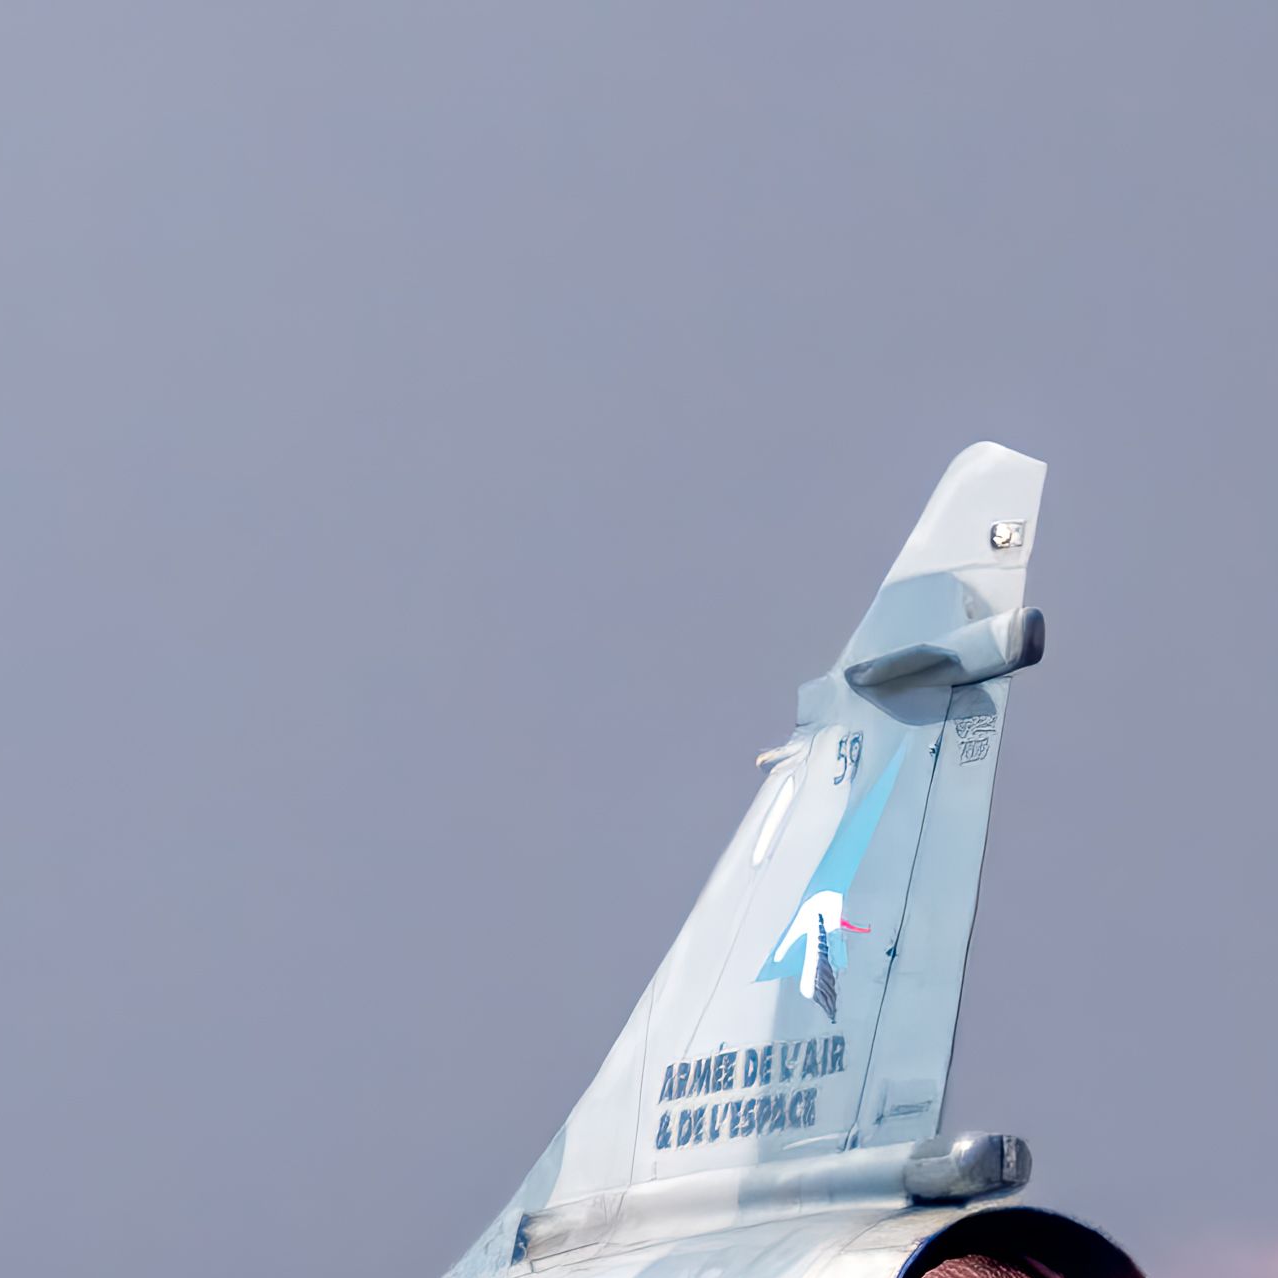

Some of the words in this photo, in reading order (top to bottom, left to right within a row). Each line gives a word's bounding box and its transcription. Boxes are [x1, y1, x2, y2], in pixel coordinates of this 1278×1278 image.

[833, 731, 864, 785] 59
[658, 1041, 739, 1104] ARMÉE
[743, 1044, 774, 1088] DE
[779, 1034, 846, 1082] L'AIR
[655, 1110, 672, 1150] &
[676, 1103, 707, 1148] DE
[708, 1087, 819, 1143] L'ESPACE
